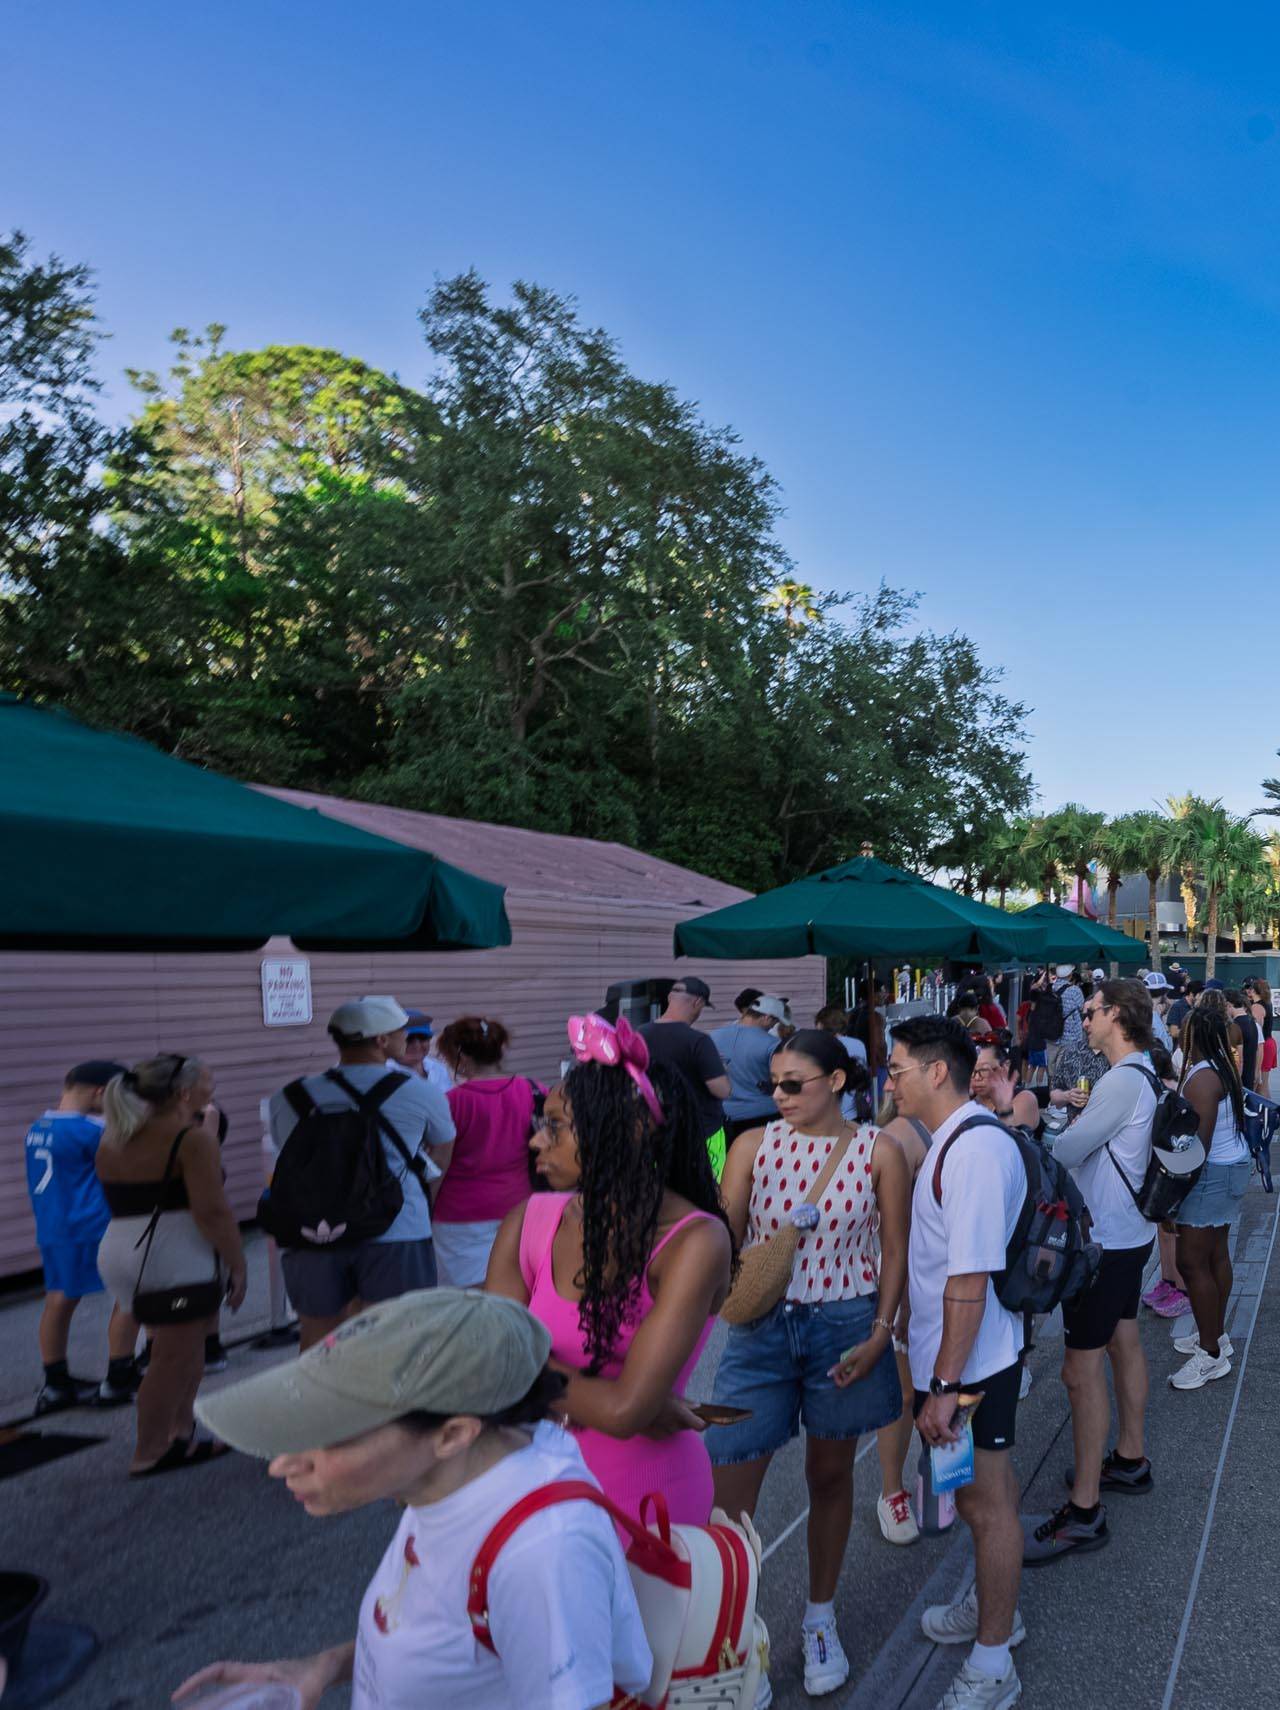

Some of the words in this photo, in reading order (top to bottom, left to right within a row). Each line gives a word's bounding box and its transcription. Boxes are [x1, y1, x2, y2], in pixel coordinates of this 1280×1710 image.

[280, 966, 293, 976] NO
[267, 979, 305, 990] PARKING
[34, 1148, 53, 1195] 7
